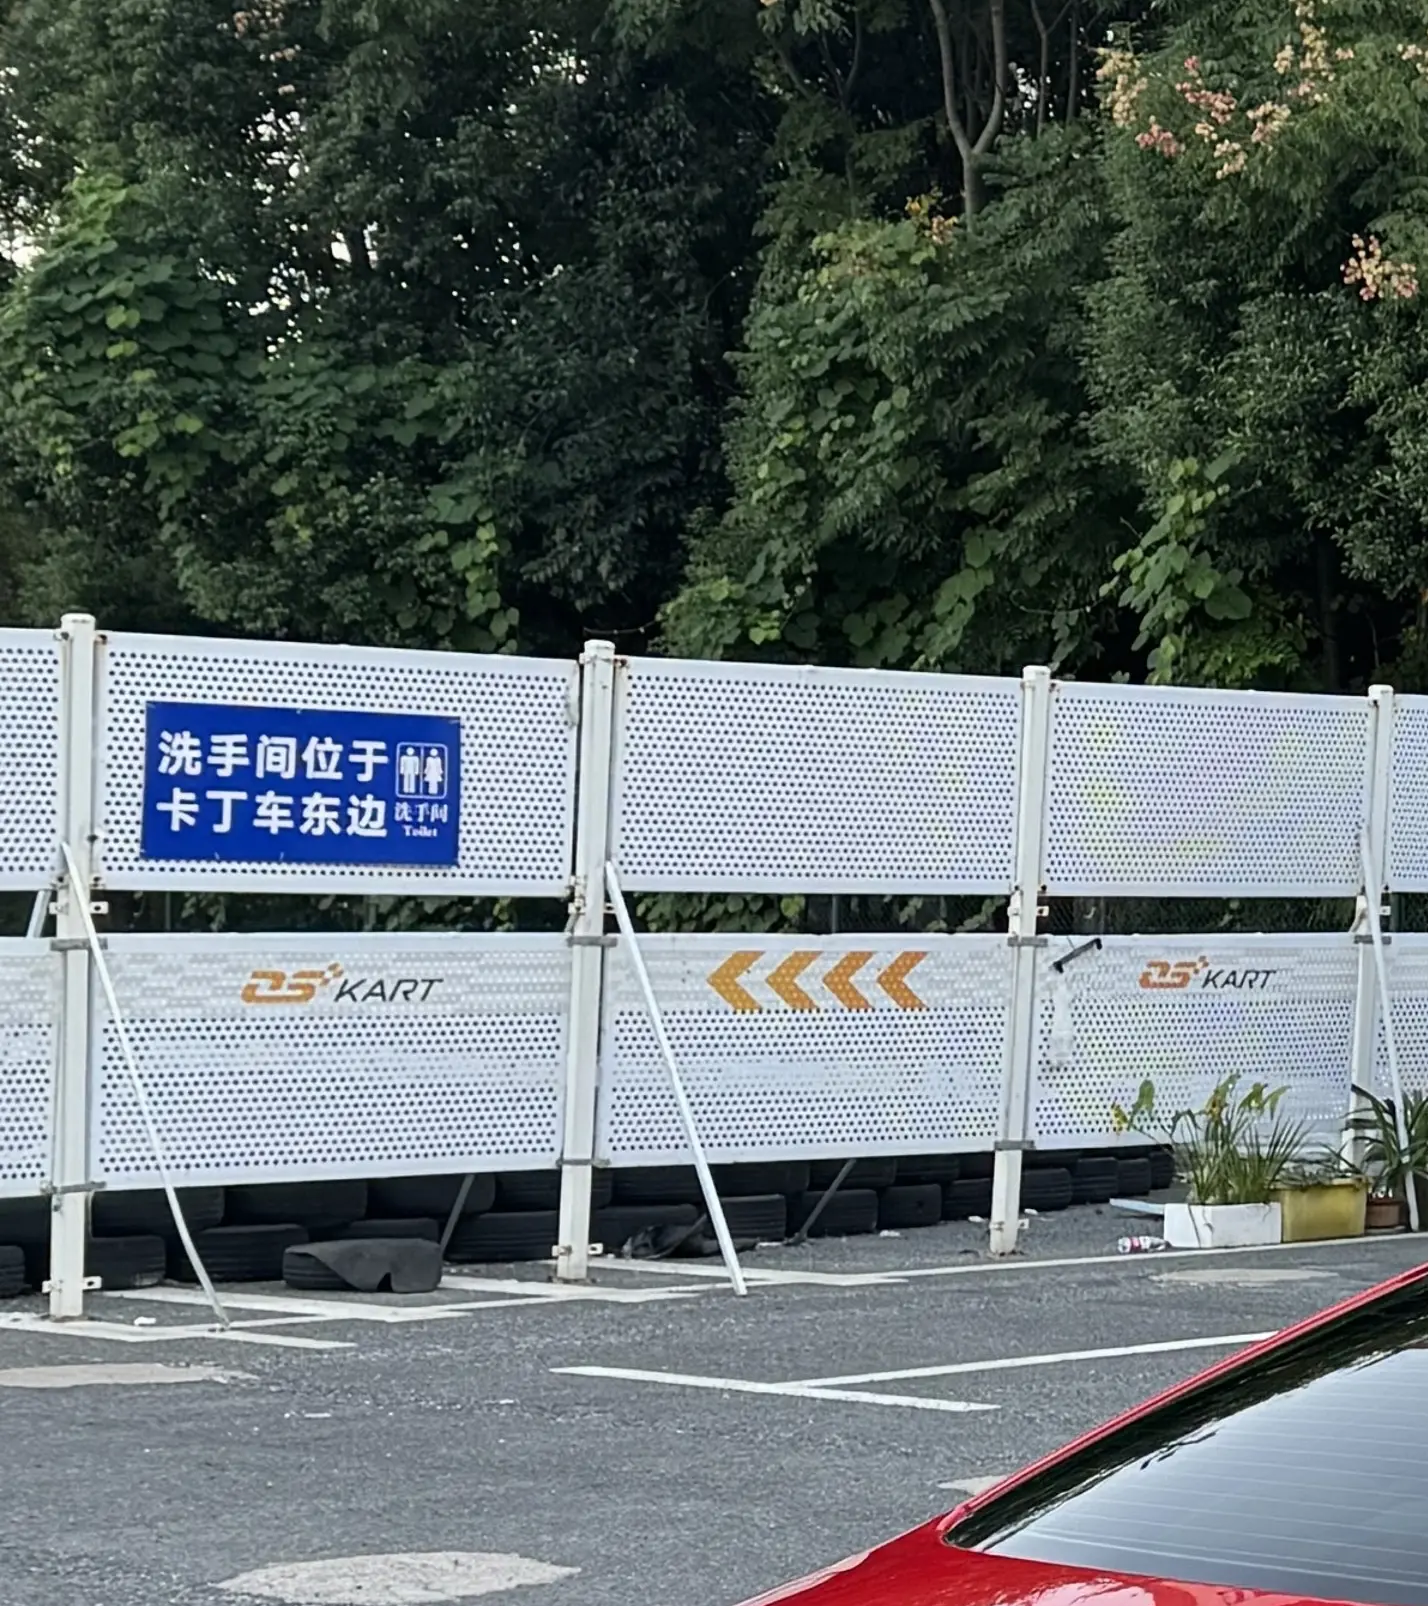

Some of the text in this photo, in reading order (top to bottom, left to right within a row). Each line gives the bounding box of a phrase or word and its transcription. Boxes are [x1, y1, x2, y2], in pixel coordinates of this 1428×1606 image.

[158, 730, 388, 782] 洗手间位于
[156, 787, 387, 838] 卡丁车东边
[395, 802, 448, 824] 洗手间
[334, 978, 445, 1002] KART
[1201, 969, 1277, 989] KART
